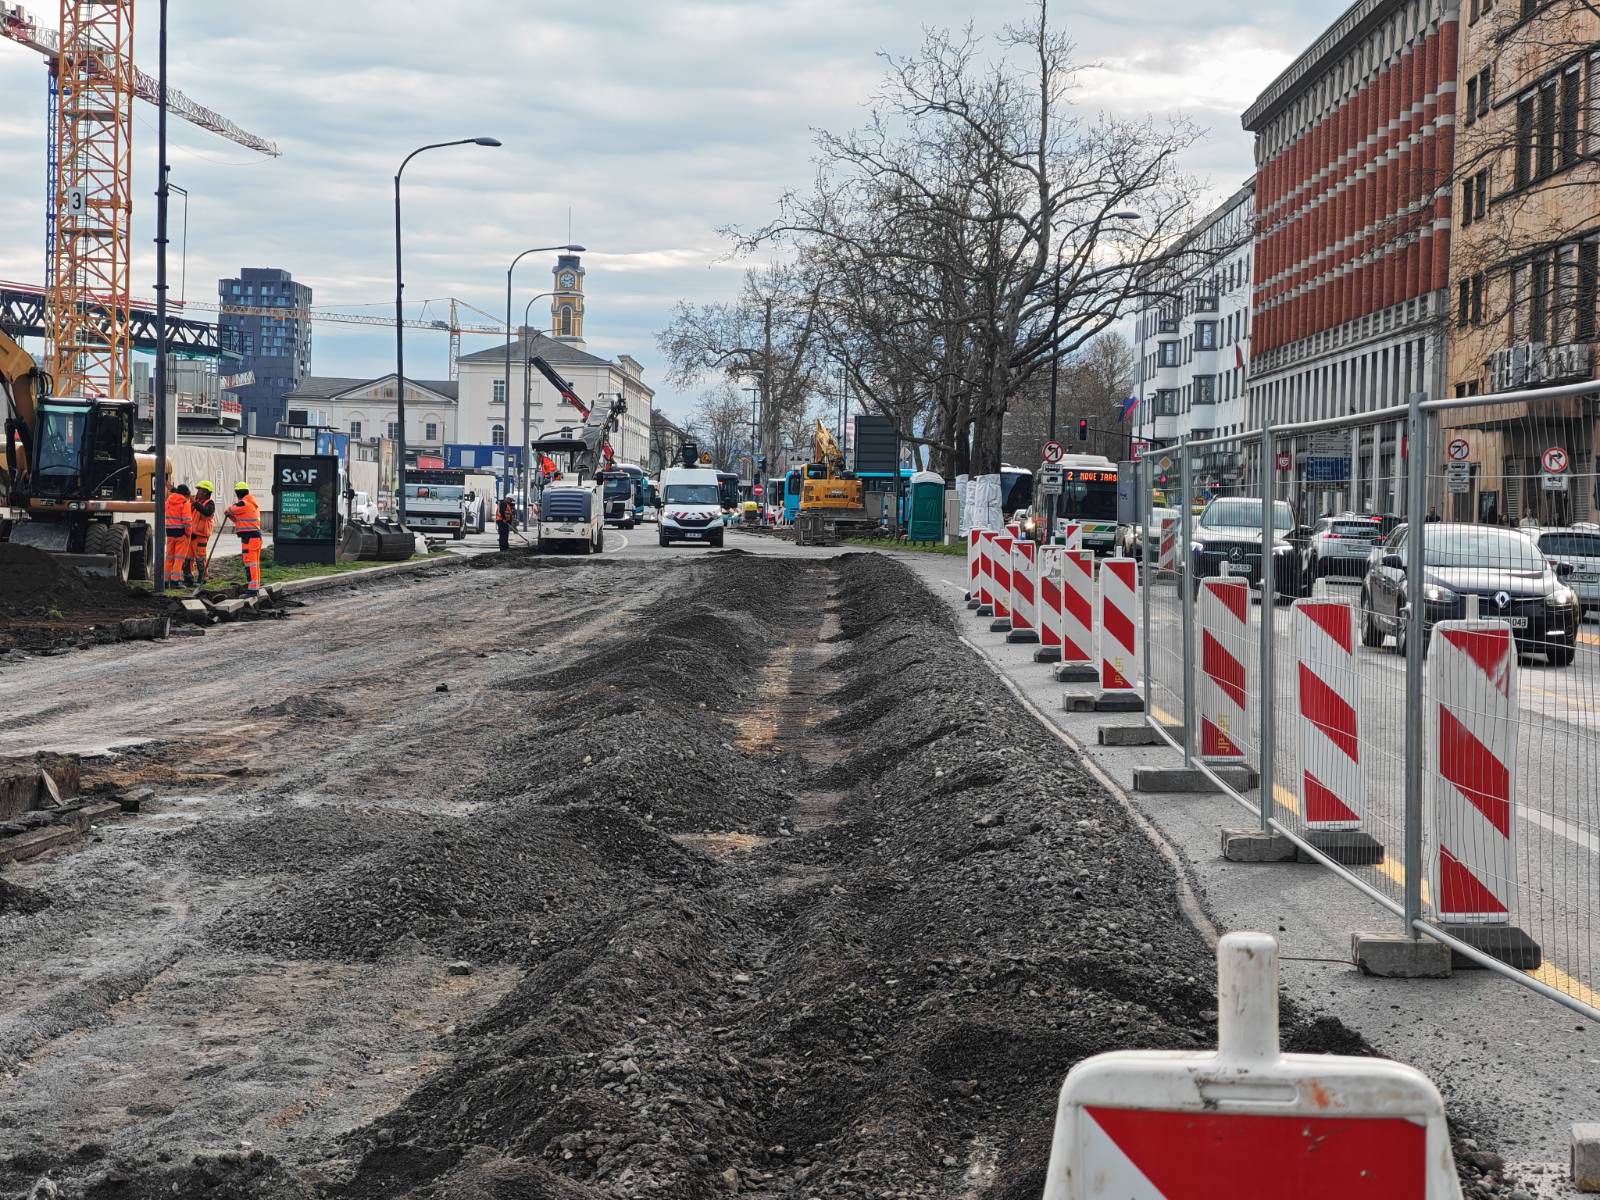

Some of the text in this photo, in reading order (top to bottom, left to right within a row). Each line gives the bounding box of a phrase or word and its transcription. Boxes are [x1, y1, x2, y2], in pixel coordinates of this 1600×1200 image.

[72, 192, 81, 209] 3
[1067, 471, 1073, 480] 2
[1080, 472, 1097, 481] NOVE
